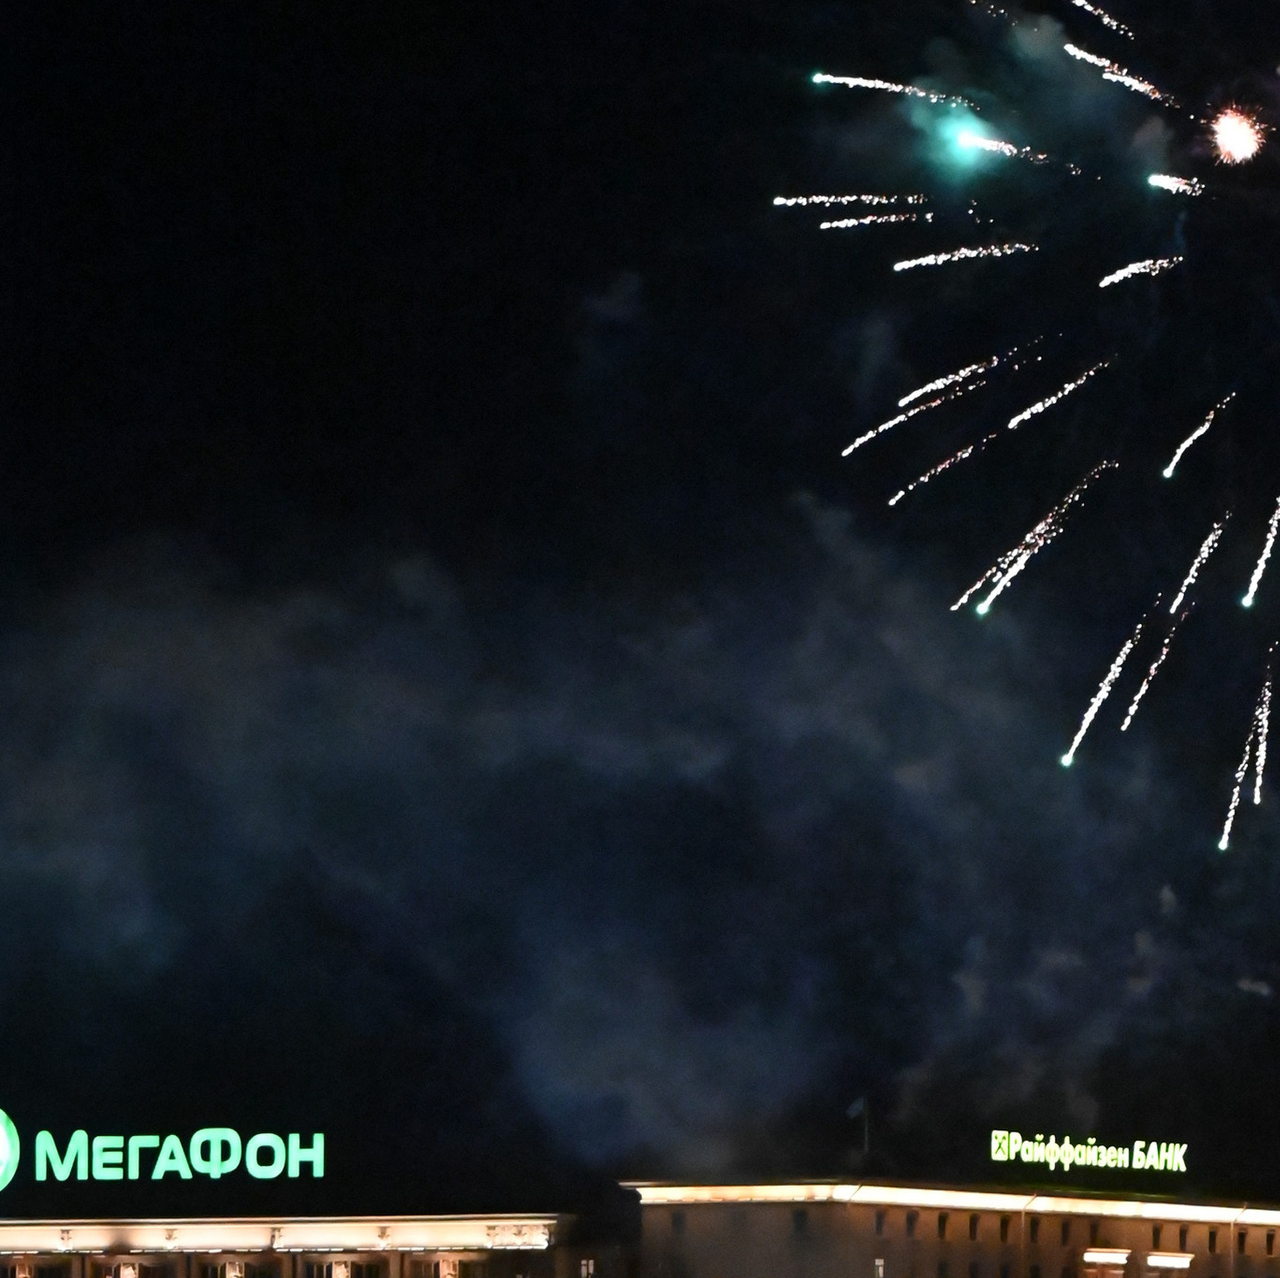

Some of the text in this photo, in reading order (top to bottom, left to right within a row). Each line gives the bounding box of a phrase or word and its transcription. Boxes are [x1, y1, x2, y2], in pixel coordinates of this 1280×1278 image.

[35, 1127, 325, 1182] МЕГАФОН
[1009, 1131, 1188, 1173] Райффайзен БАНК
